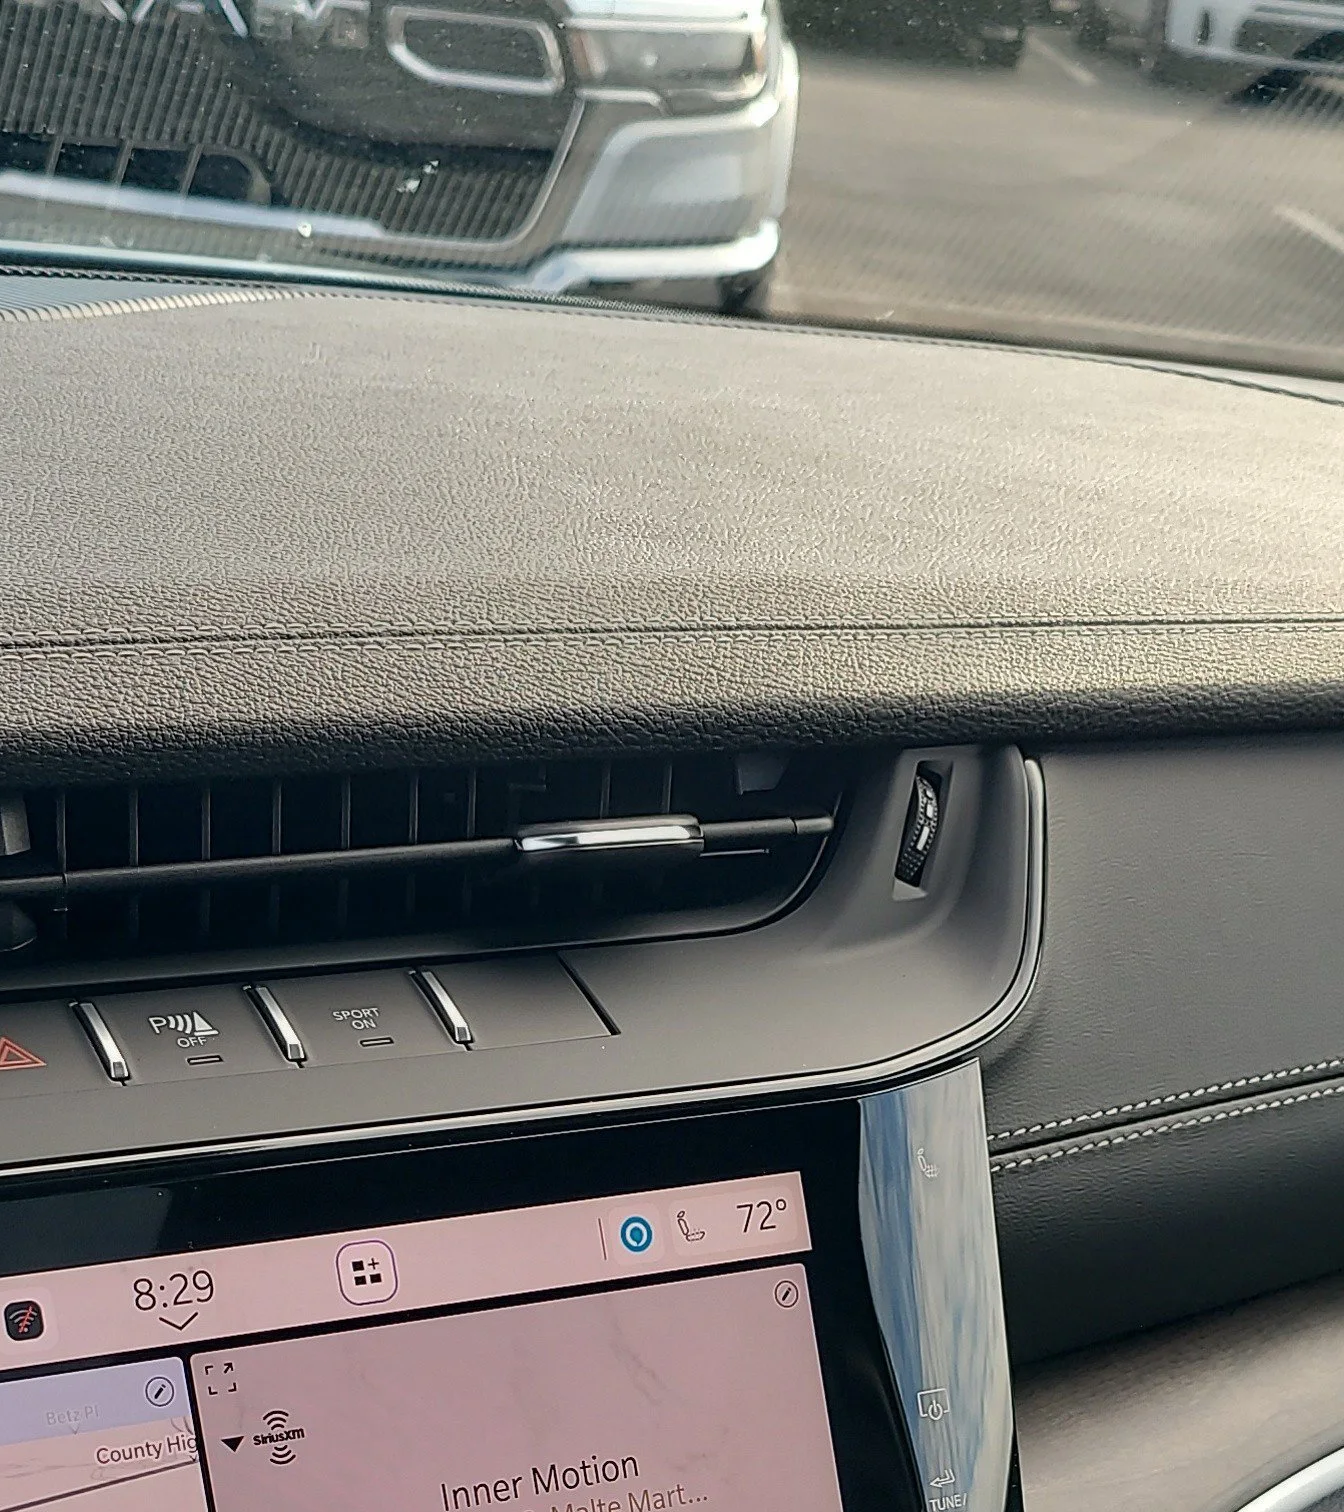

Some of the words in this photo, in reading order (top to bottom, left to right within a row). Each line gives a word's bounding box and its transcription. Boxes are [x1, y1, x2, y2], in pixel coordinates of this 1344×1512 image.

[332, 1007, 381, 1021] SPORT
[352, 1018, 377, 1031] ON
[176, 1036, 207, 1049] OFF
[736, 1197, 788, 1235] 72°
[132, 1270, 214, 1312] 8:29
[96, 1442, 162, 1464] County
[167, 1434, 197, 1453] Hig
[441, 1474, 524, 1512] Inner
[531, 1451, 640, 1494] Motion
[929, 1493, 967, 1512] TUNE/
